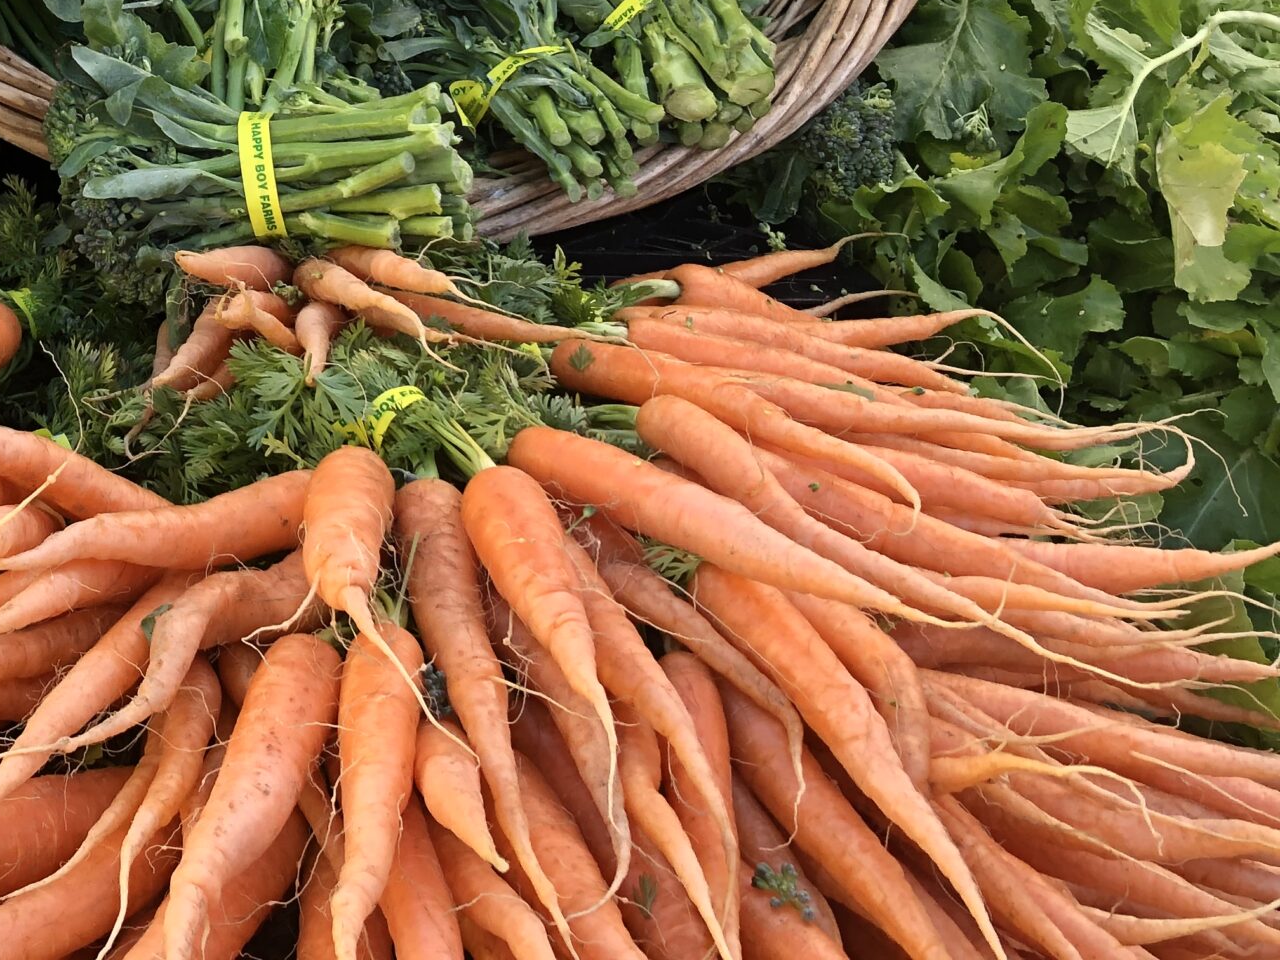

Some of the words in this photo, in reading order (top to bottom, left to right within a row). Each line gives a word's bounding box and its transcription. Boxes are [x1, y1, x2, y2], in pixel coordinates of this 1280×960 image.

[251, 122, 265, 160] HAPPY
[255, 164, 267, 190] BOY
[260, 194, 277, 231] FARMS
